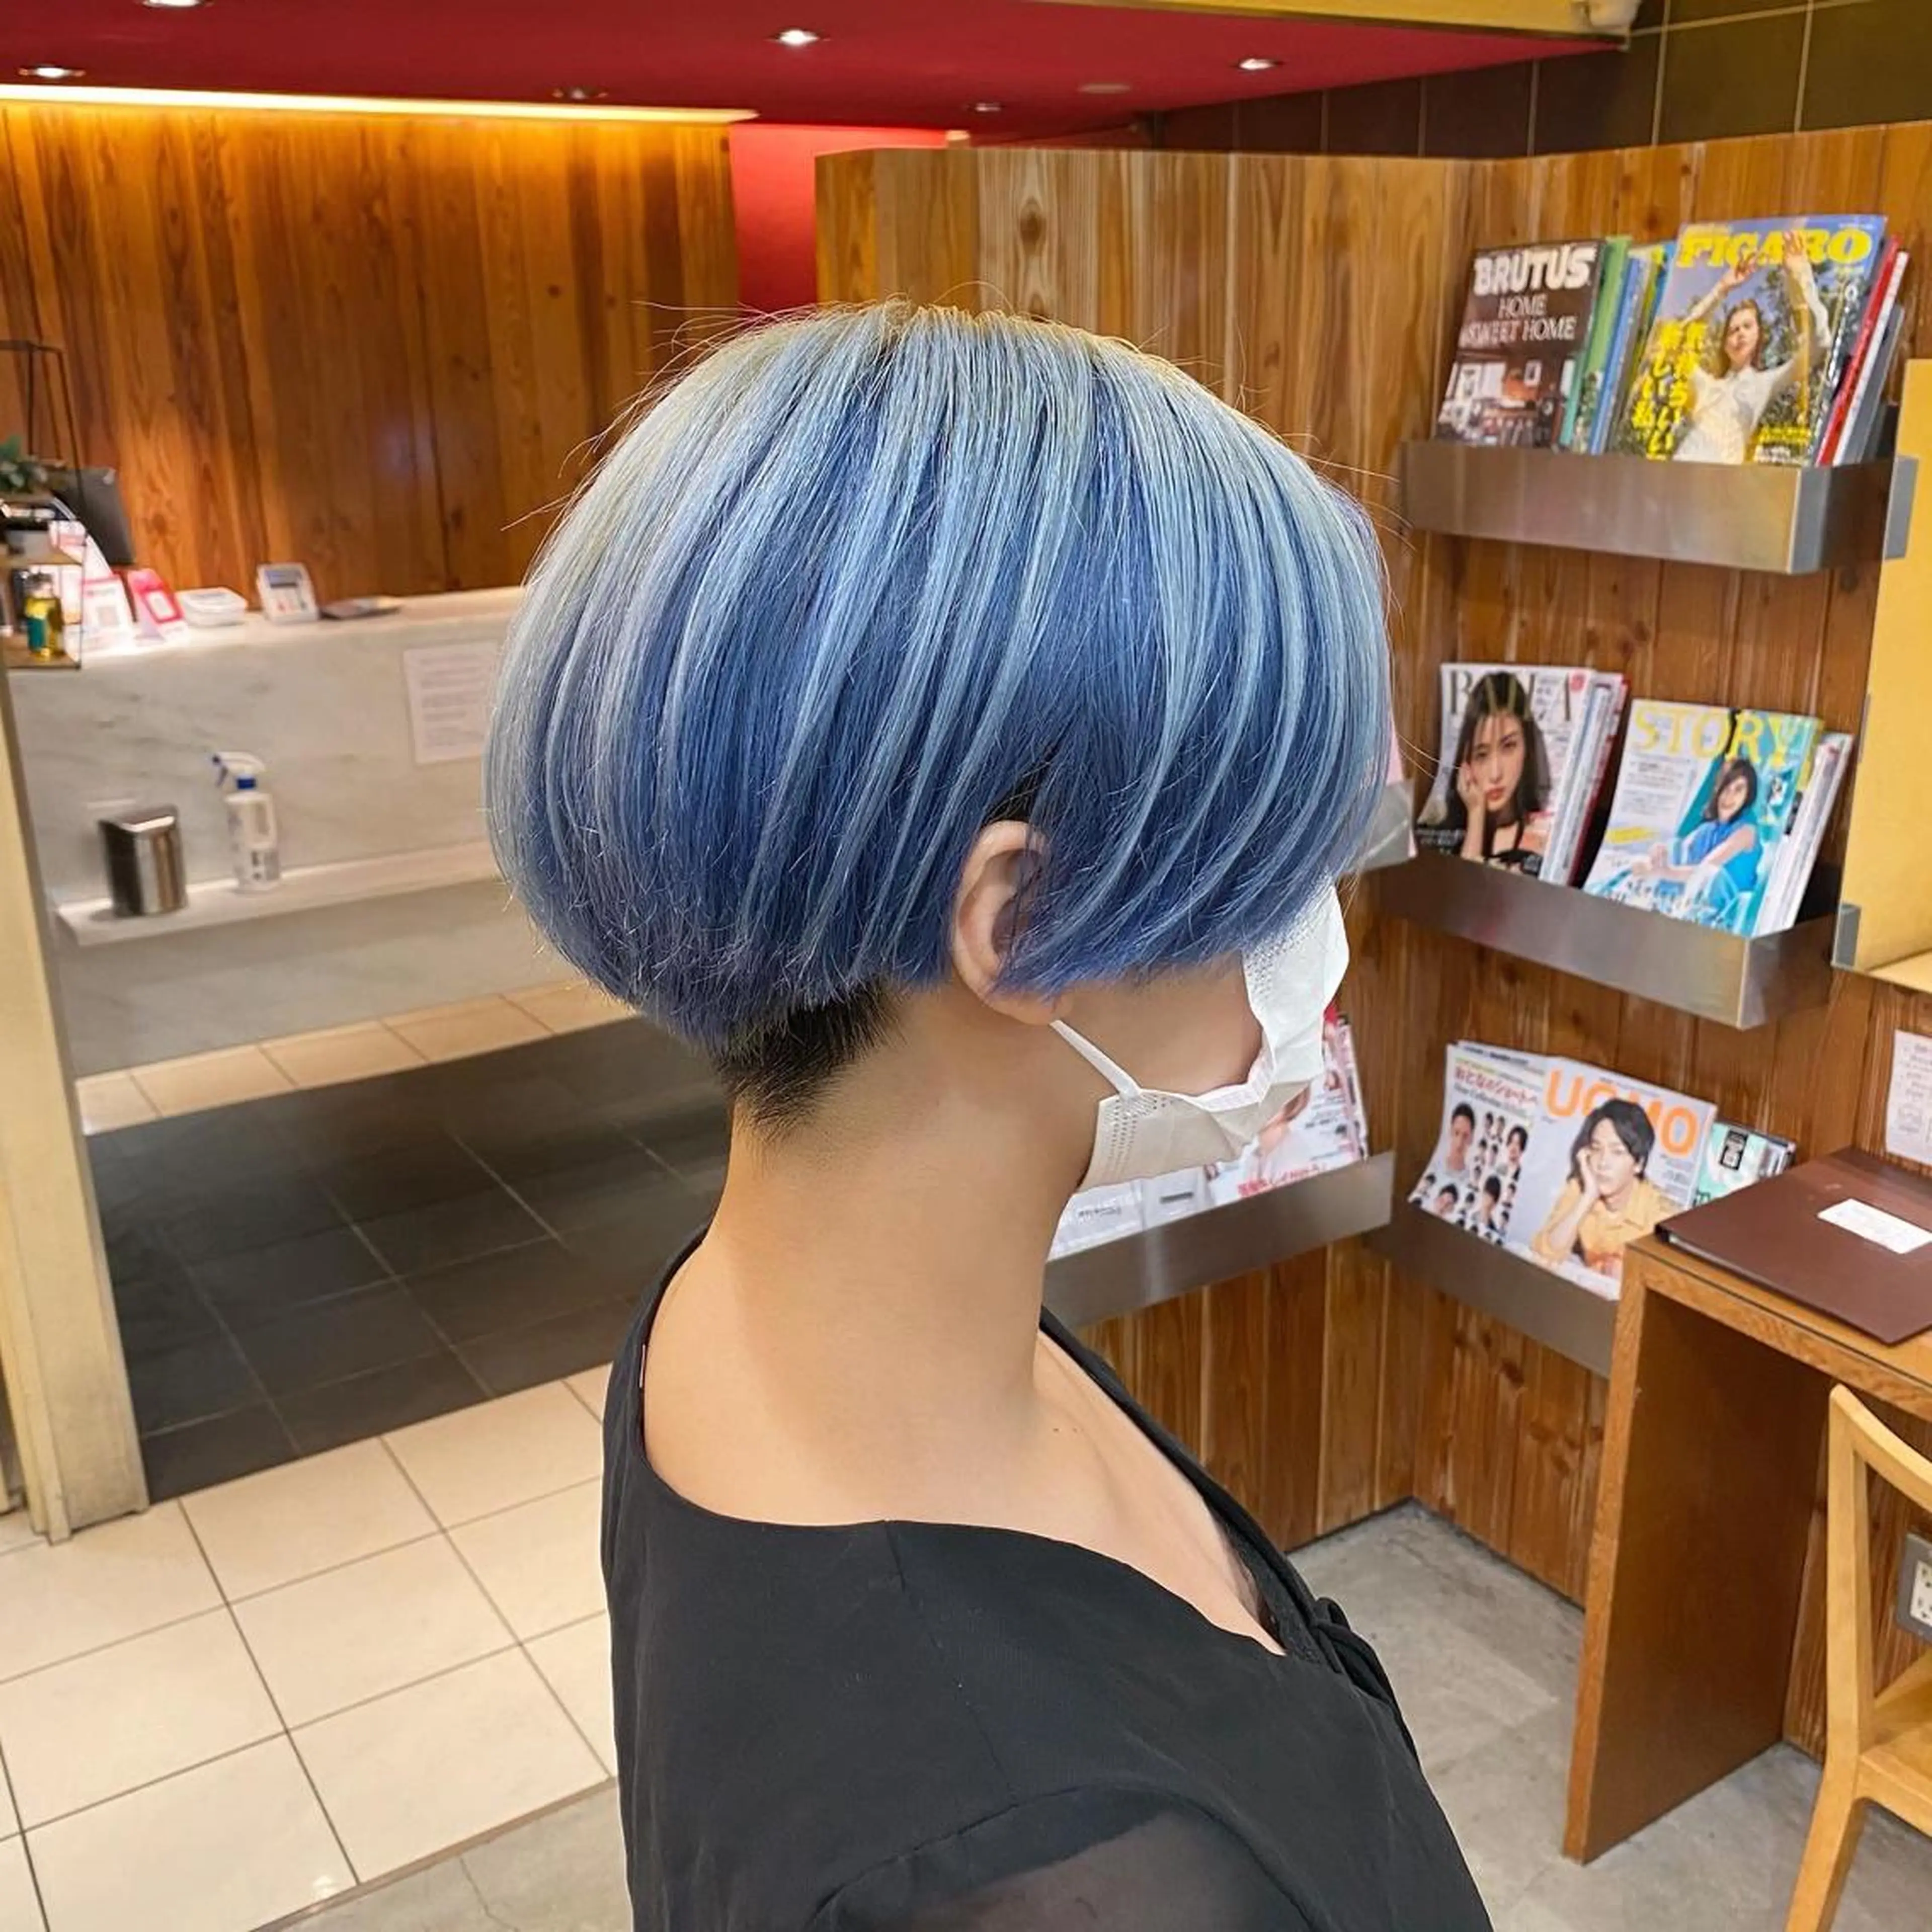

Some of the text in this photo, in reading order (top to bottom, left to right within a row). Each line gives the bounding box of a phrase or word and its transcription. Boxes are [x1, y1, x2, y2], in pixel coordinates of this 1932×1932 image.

[1676, 227, 1872, 268] FIGARO
[1474, 244, 1597, 296] BRUTUS
[1498, 294, 1548, 319] HOME
[1463, 315, 1578, 348] SWEET HOME
[1634, 705, 1799, 769] STORY
